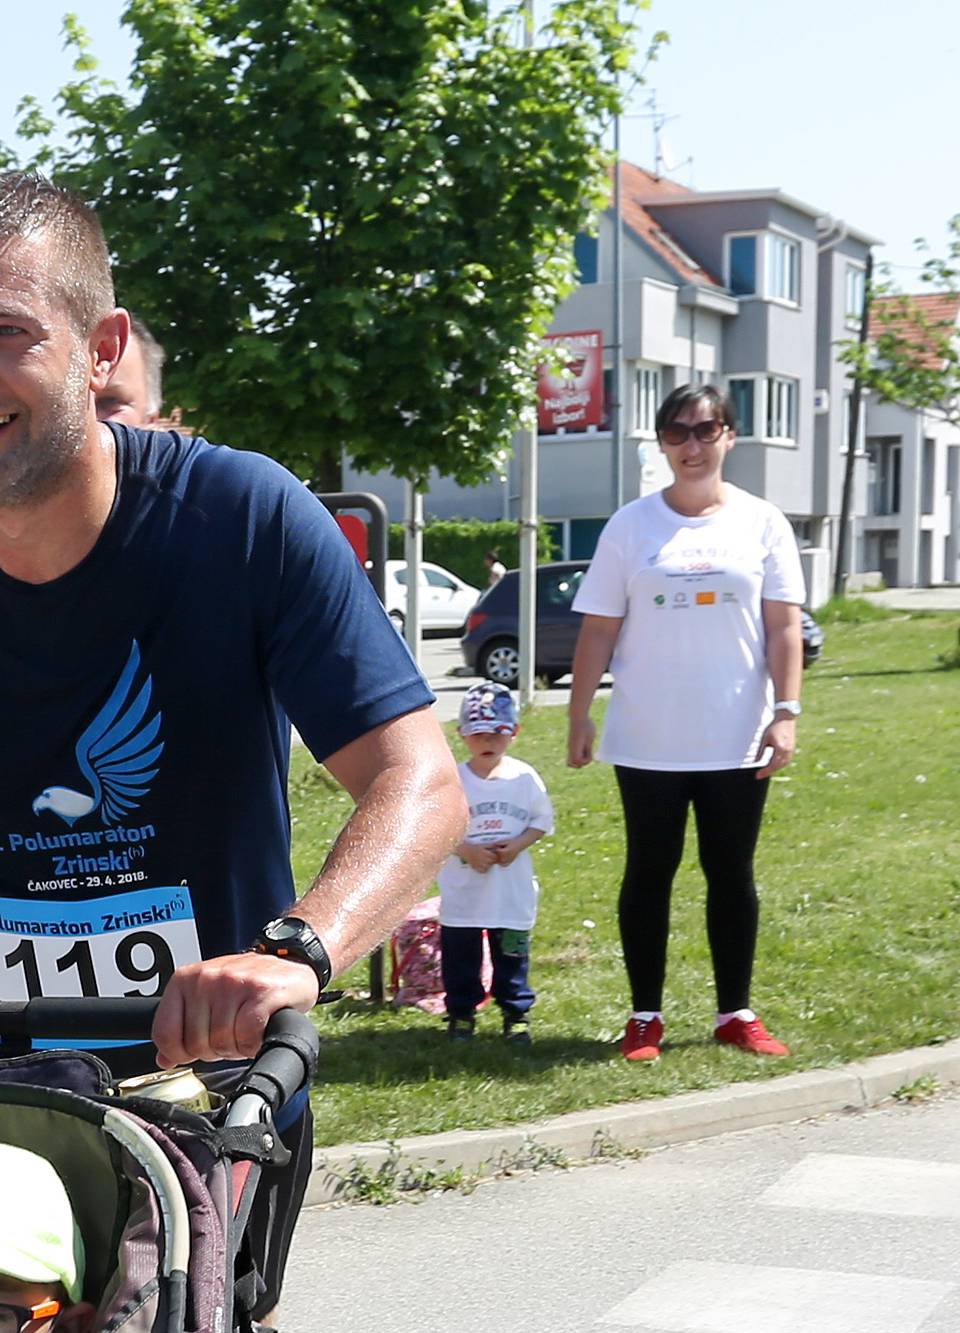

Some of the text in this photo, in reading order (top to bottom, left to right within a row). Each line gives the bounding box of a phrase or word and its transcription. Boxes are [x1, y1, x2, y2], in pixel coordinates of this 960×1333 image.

[8, 823, 156, 852] Polumaraton
[27, 877, 78, 892] ČAKOVEC
[4, 930, 175, 998] 119
